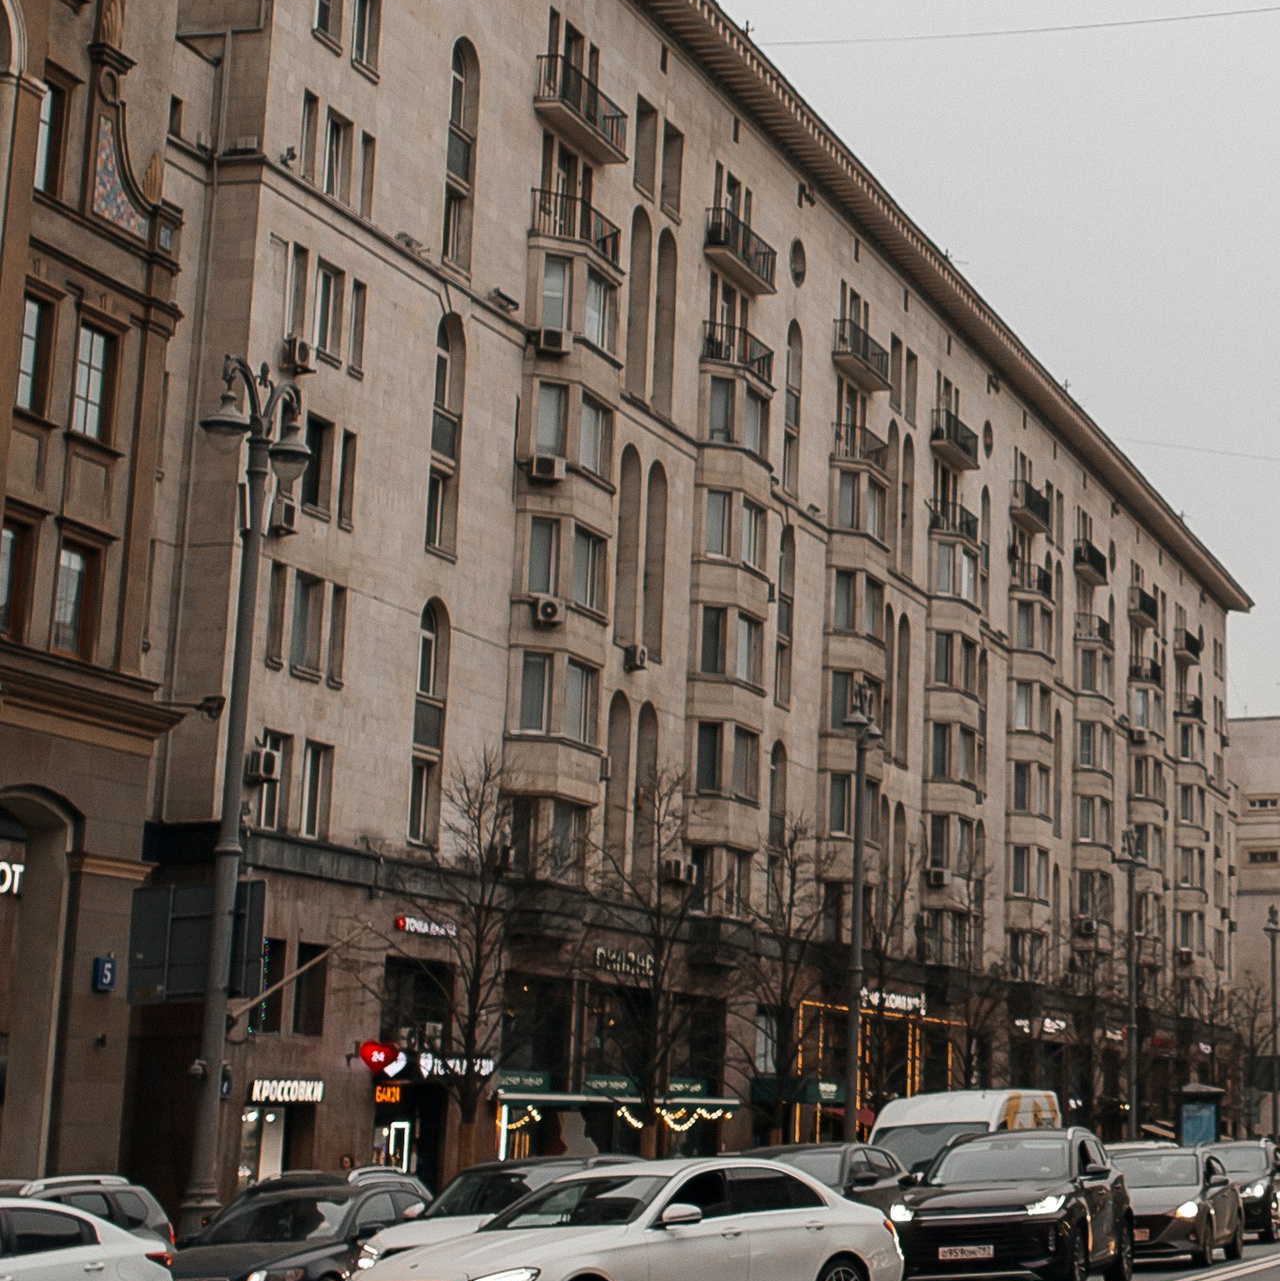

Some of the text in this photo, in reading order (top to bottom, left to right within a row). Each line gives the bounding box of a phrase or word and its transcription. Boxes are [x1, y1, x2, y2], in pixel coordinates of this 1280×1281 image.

[102, 963, 112, 984] 5
[371, 1050, 386, 1063] 24
[252, 1080, 324, 1102] КРОССОВКИ
